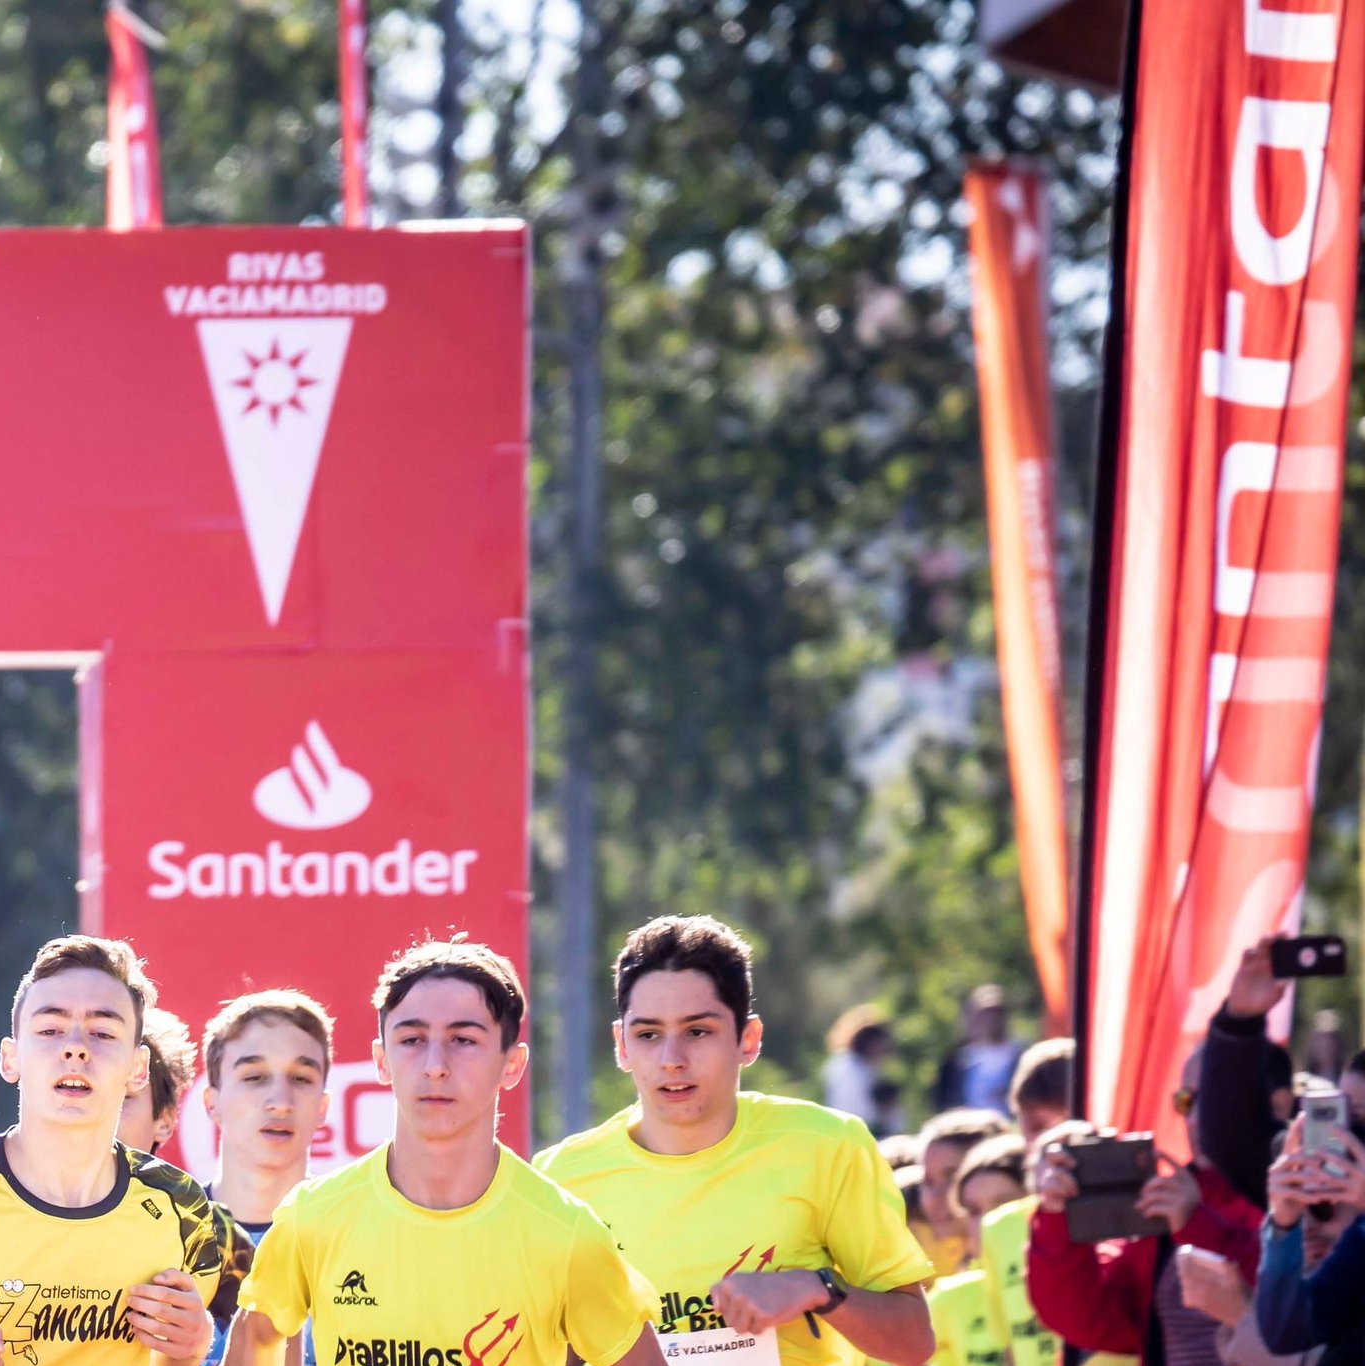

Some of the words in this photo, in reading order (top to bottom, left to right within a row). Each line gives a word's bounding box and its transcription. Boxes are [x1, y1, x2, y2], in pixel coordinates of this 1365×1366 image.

[227, 252, 325, 281] RIVAS
[165, 284, 386, 315] VACIAMADRID
[148, 838, 478, 899] Santander
[40, 1285, 111, 1301] atletismo
[683, 1337, 757, 1356] VACIAMADRID
